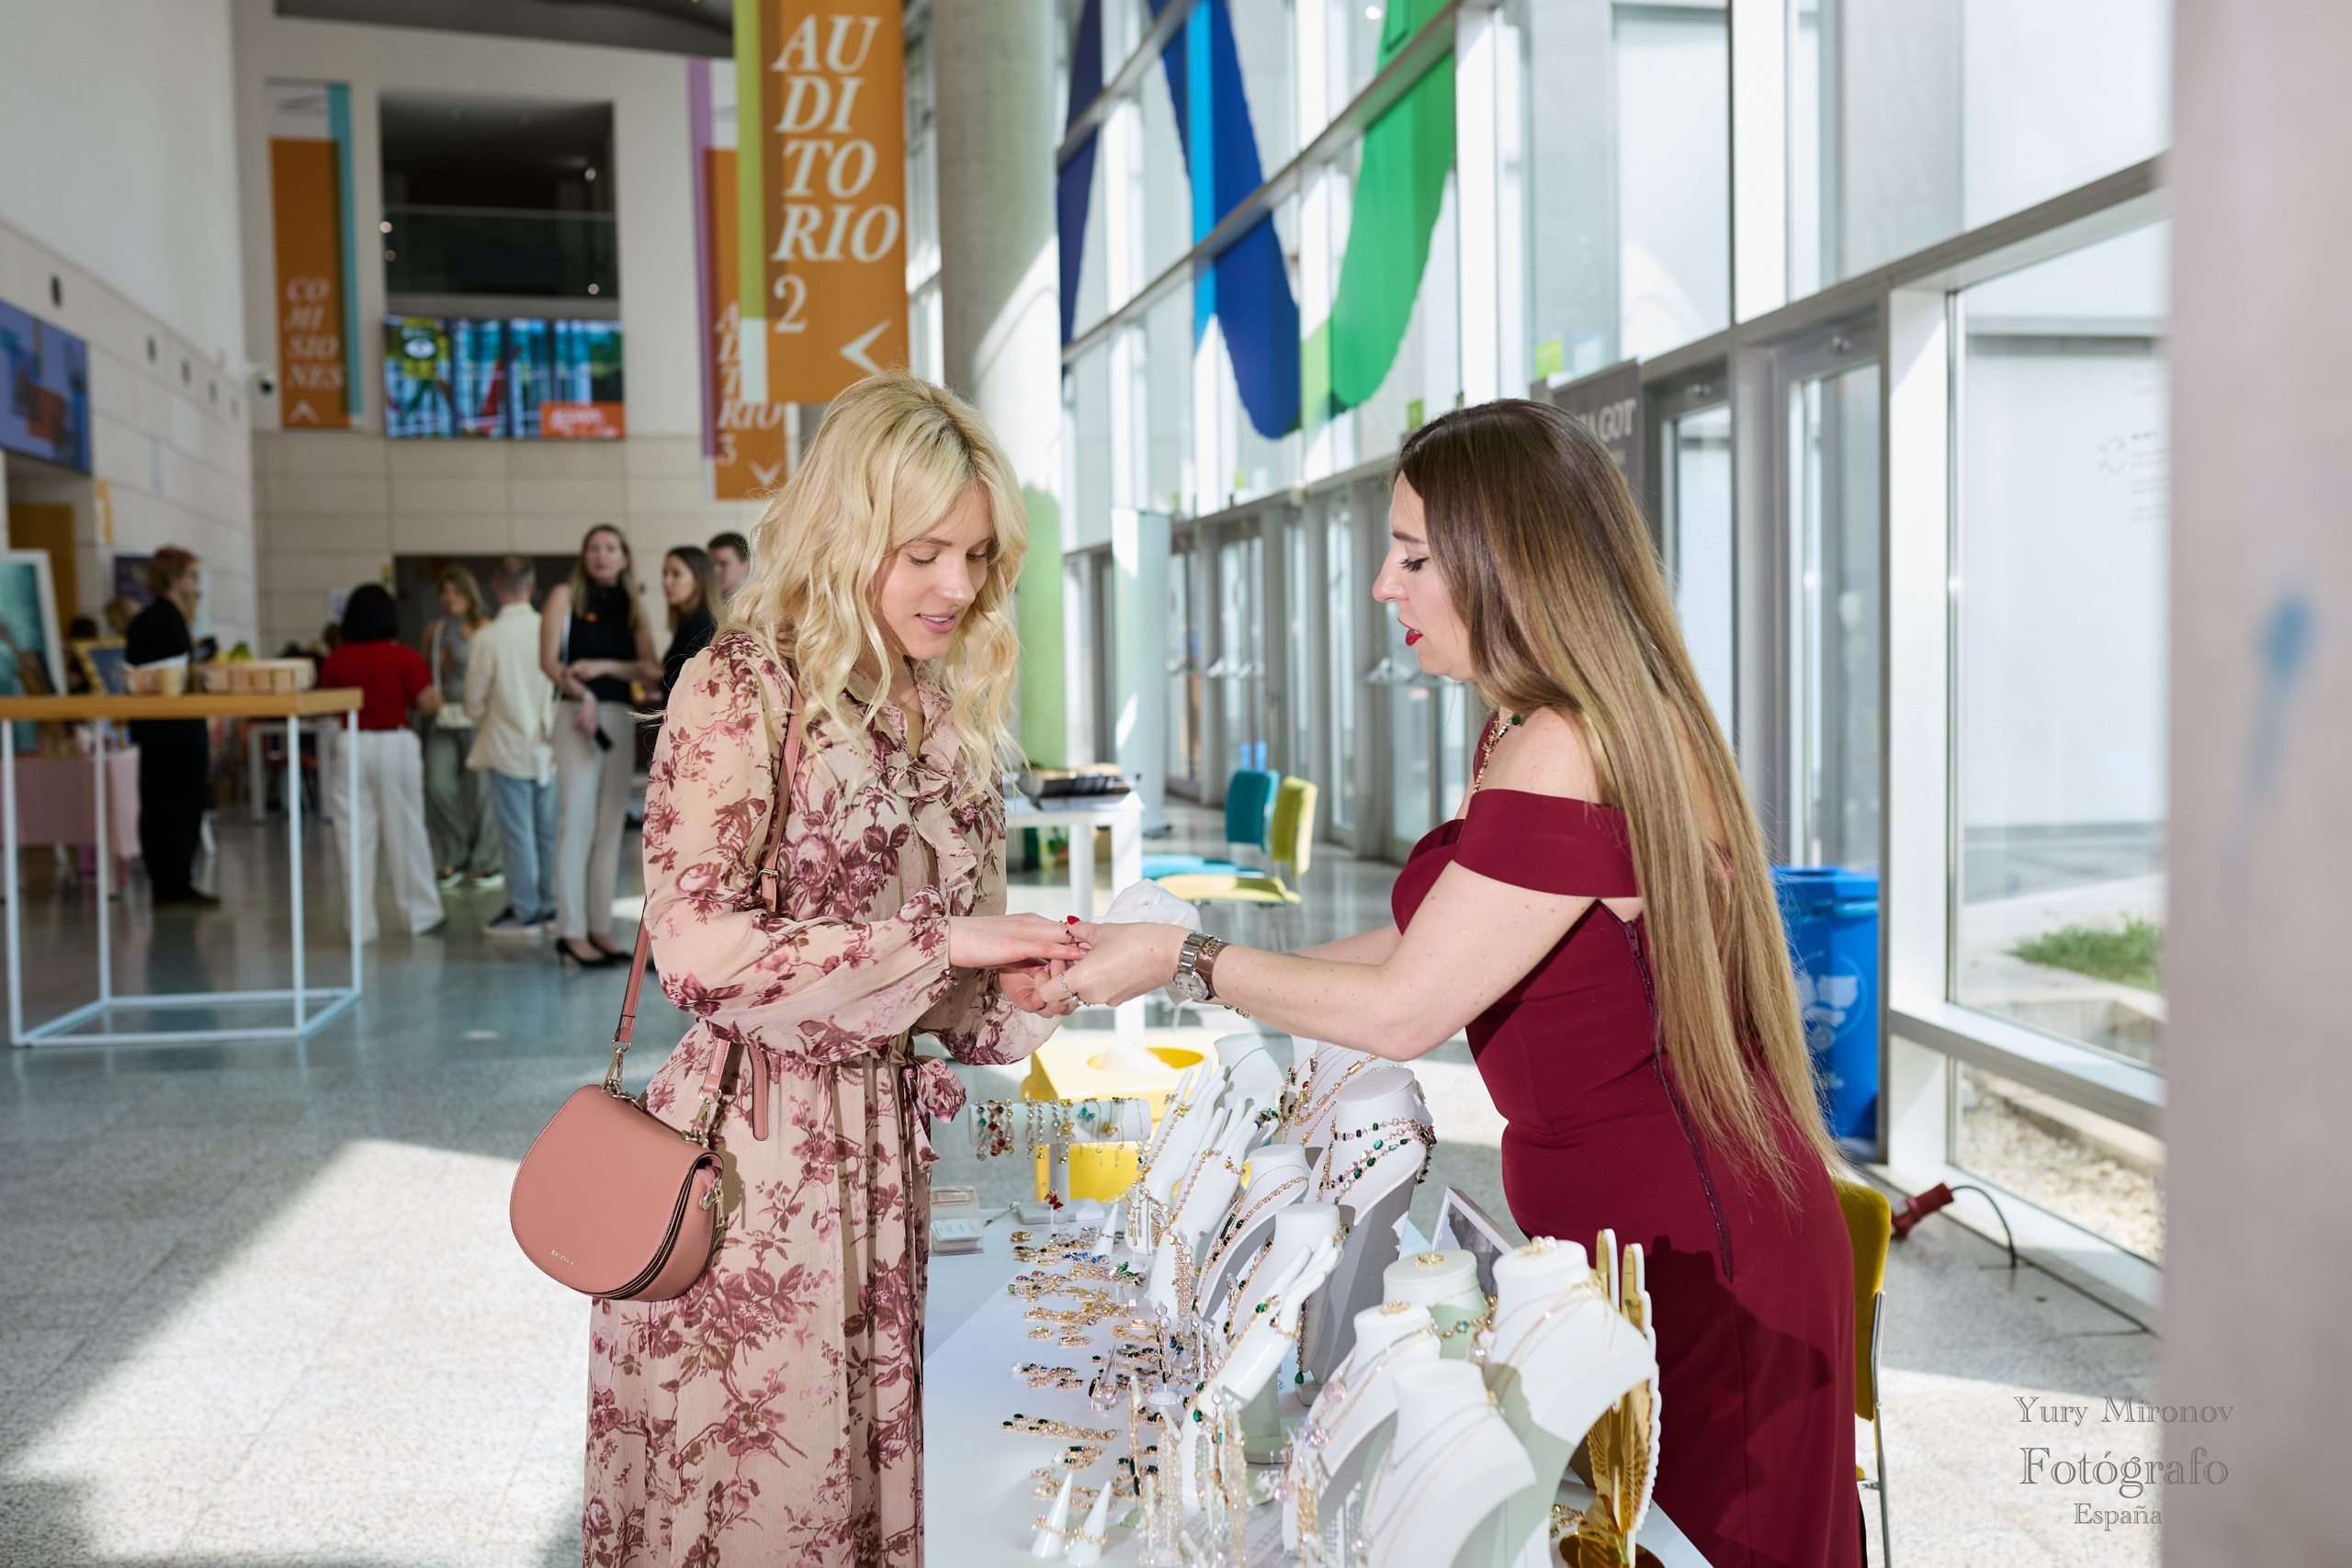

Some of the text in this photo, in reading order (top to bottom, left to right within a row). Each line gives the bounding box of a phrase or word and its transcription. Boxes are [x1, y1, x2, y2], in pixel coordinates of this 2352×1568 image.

[769, 13, 883, 73] AU
[773, 74, 865, 134] DI
[782, 139, 877, 198] TO
[769, 202, 900, 264] RIO
[285, 275, 331, 304] CO
[774, 274, 808, 333] 2
